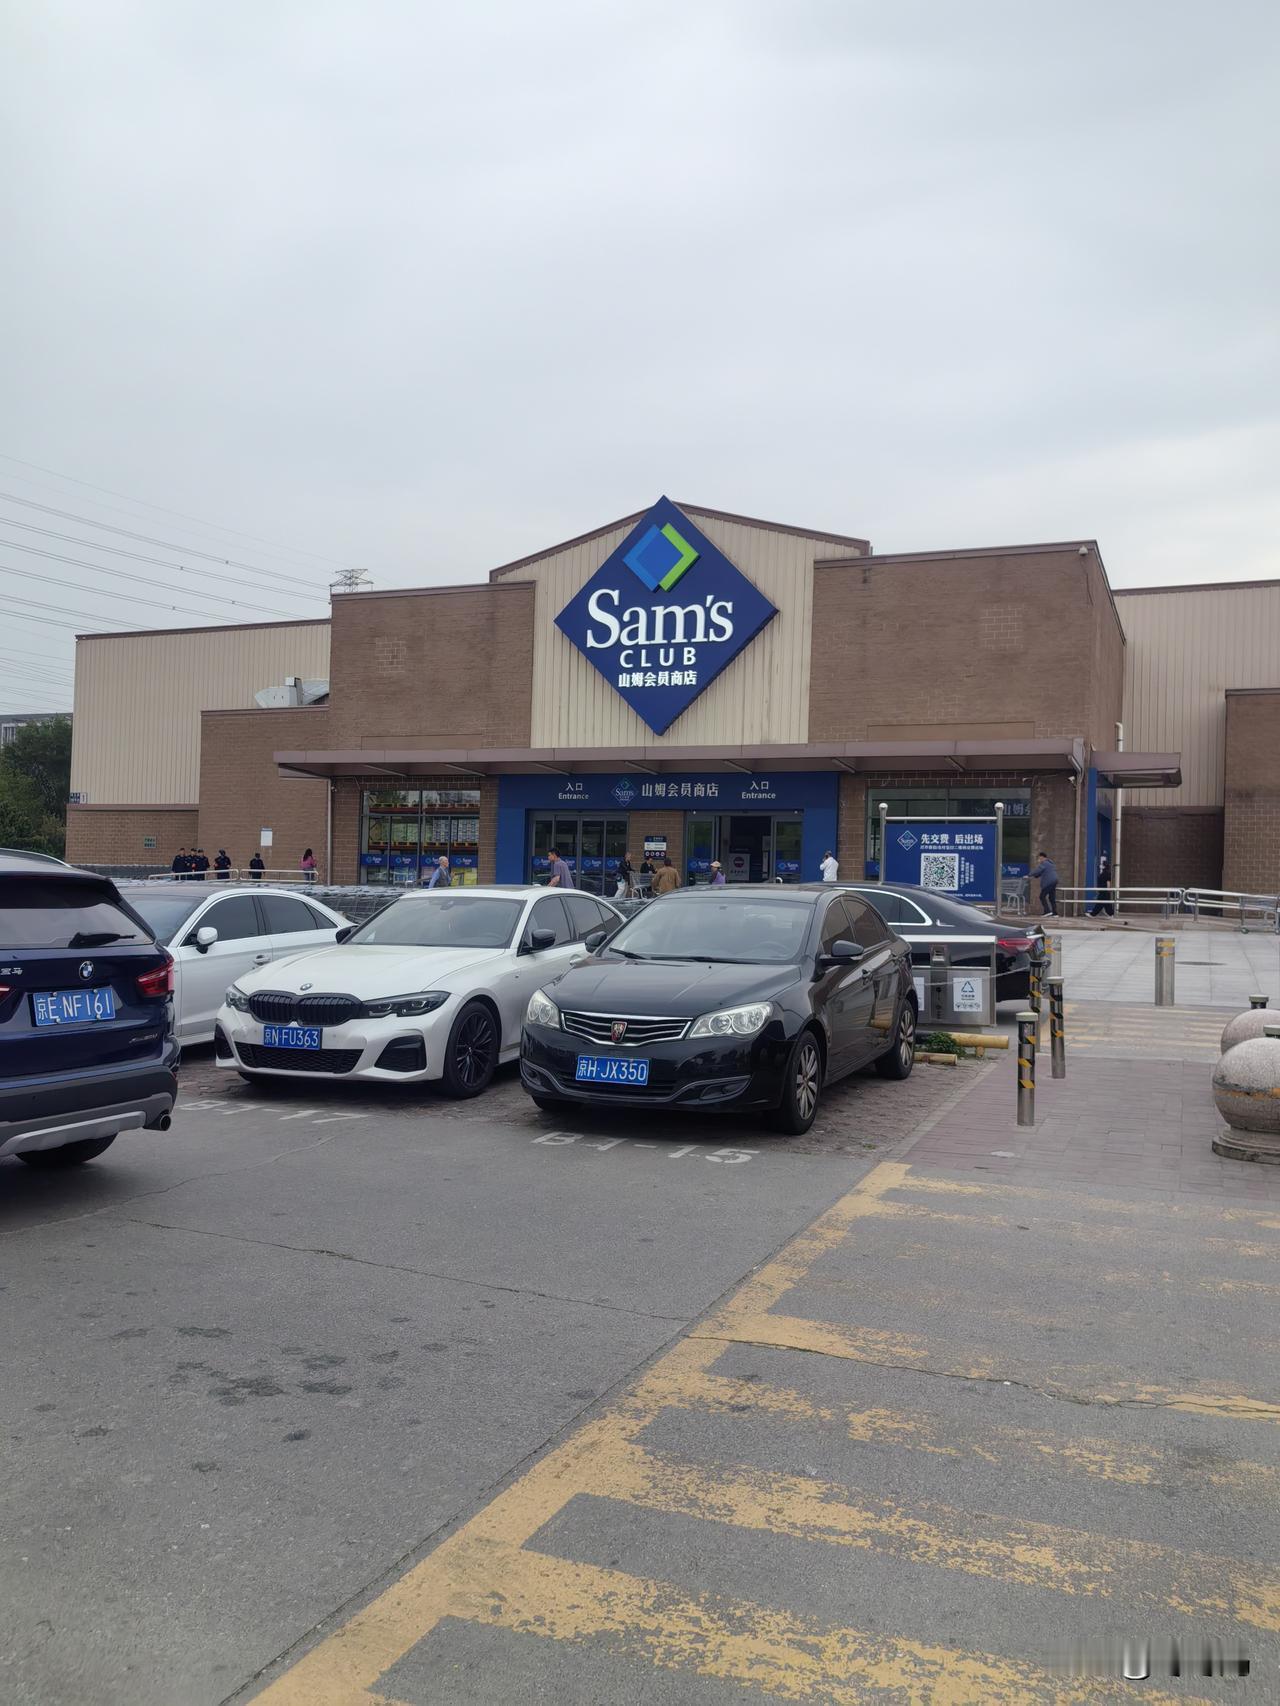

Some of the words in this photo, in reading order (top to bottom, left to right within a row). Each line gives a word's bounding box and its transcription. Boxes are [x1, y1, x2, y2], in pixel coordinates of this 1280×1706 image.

[587, 588, 734, 649] Sam's
[619, 647, 696, 668] CLUB
[618, 670, 698, 687] 山姆会员商店
[565, 782, 583, 791] 入口
[641, 783, 719, 797] 山姆会员商店
[750, 781, 769, 790] 入口
[558, 792, 590, 800] Entrance
[741, 791, 776, 799] Entrance
[921, 833, 949, 844] 先交费
[954, 833, 983, 844] 后出场
